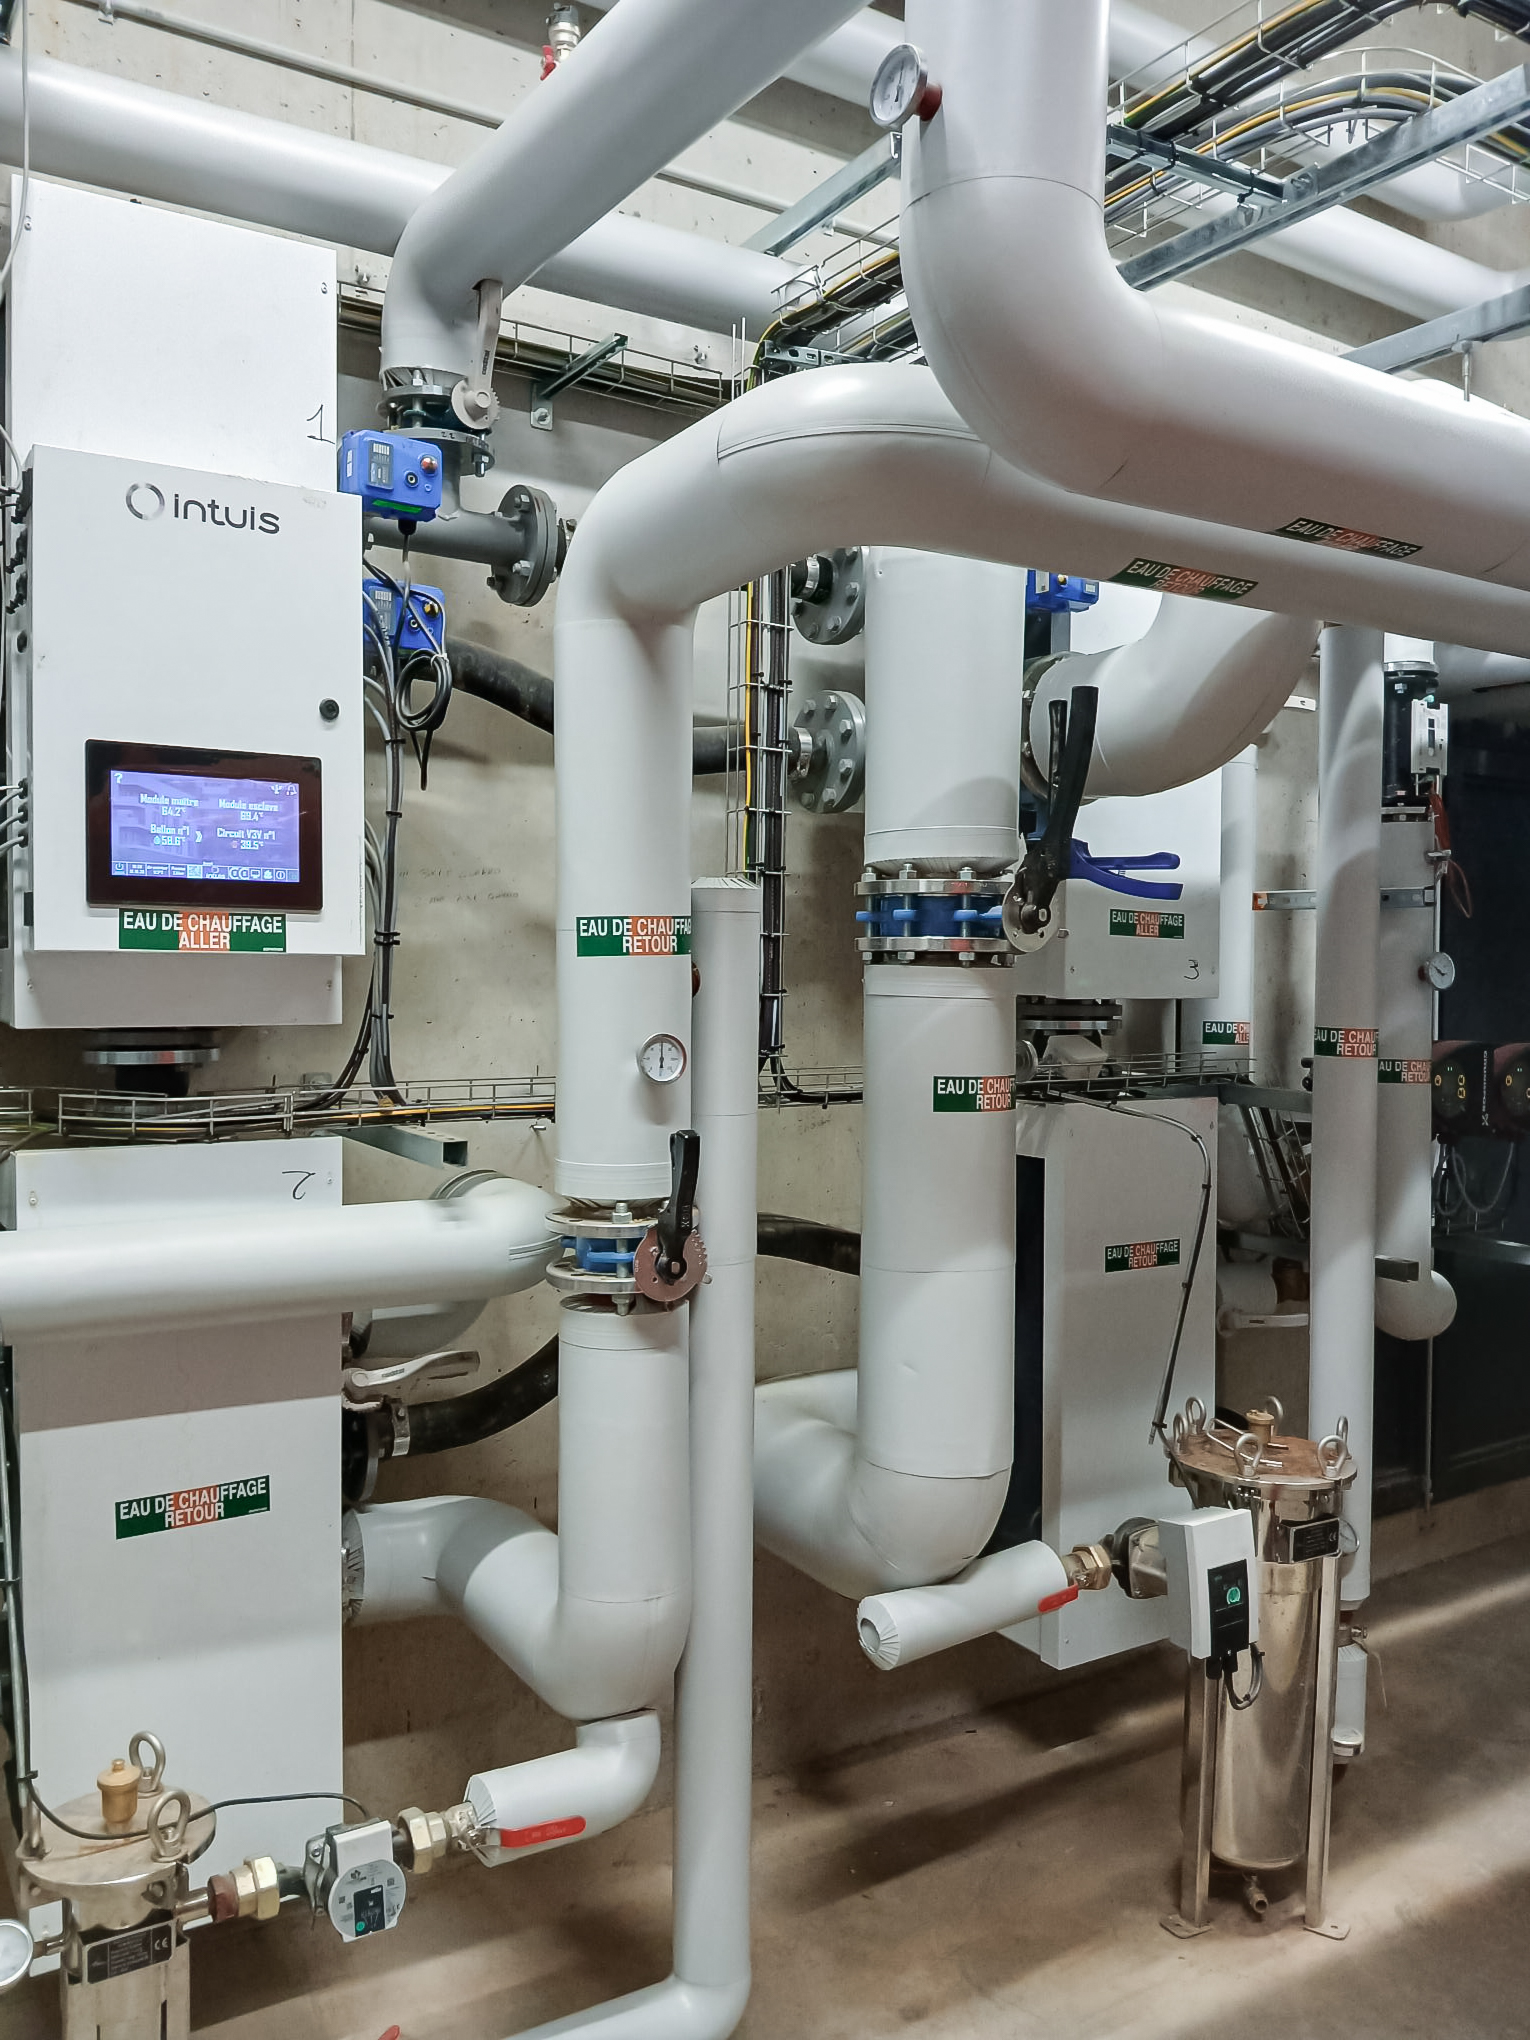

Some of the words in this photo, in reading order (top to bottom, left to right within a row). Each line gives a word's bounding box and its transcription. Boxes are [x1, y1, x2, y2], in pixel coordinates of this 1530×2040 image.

[306, 403, 335, 444] 1
[173, 493, 280, 535] intuis
[1285, 520, 1323, 535] EAU
[1127, 561, 1155, 577] EAU
[1154, 566, 1181, 580] DE
[1176, 570, 1252, 594] CHAUFFAGE
[123, 911, 157, 930] EAU
[161, 912, 183, 931] DE
[187, 914, 283, 933] CHAUFFAGE
[579, 919, 608, 936] EAU
[612, 918, 633, 935] DE
[1112, 911, 1127, 923] EAU
[1128, 912, 1138, 924] DE
[1140, 913, 1183, 926] CHAUFFAGE
[1136, 924, 1159, 936] ALLER
[178, 931, 230, 949] ALLER
[622, 935, 677, 952] RETOUR
[1183, 959, 1199, 980] 3
[1205, 1022, 1224, 1033] EAU
[1226, 1023, 1238, 1034] DE
[1330, 1030, 1345, 1042] DE
[1395, 1061, 1408, 1071] DE
[937, 1079, 965, 1094] EAU
[968, 1079, 984, 1094] DE
[976, 1094, 1011, 1110] RETOUR
[1107, 1247, 1122, 1259] EAU
[1124, 1245, 1134, 1257] DE
[1135, 1240, 1179, 1256] CHAUFFAGE
[1128, 1254, 1157, 1268] RETOUR
[119, 1498, 150, 1520] EAU
[154, 1495, 175, 1513] DE
[178, 1478, 267, 1509] CHAUFFAGE
[165, 1502, 225, 1528] RETOUR
